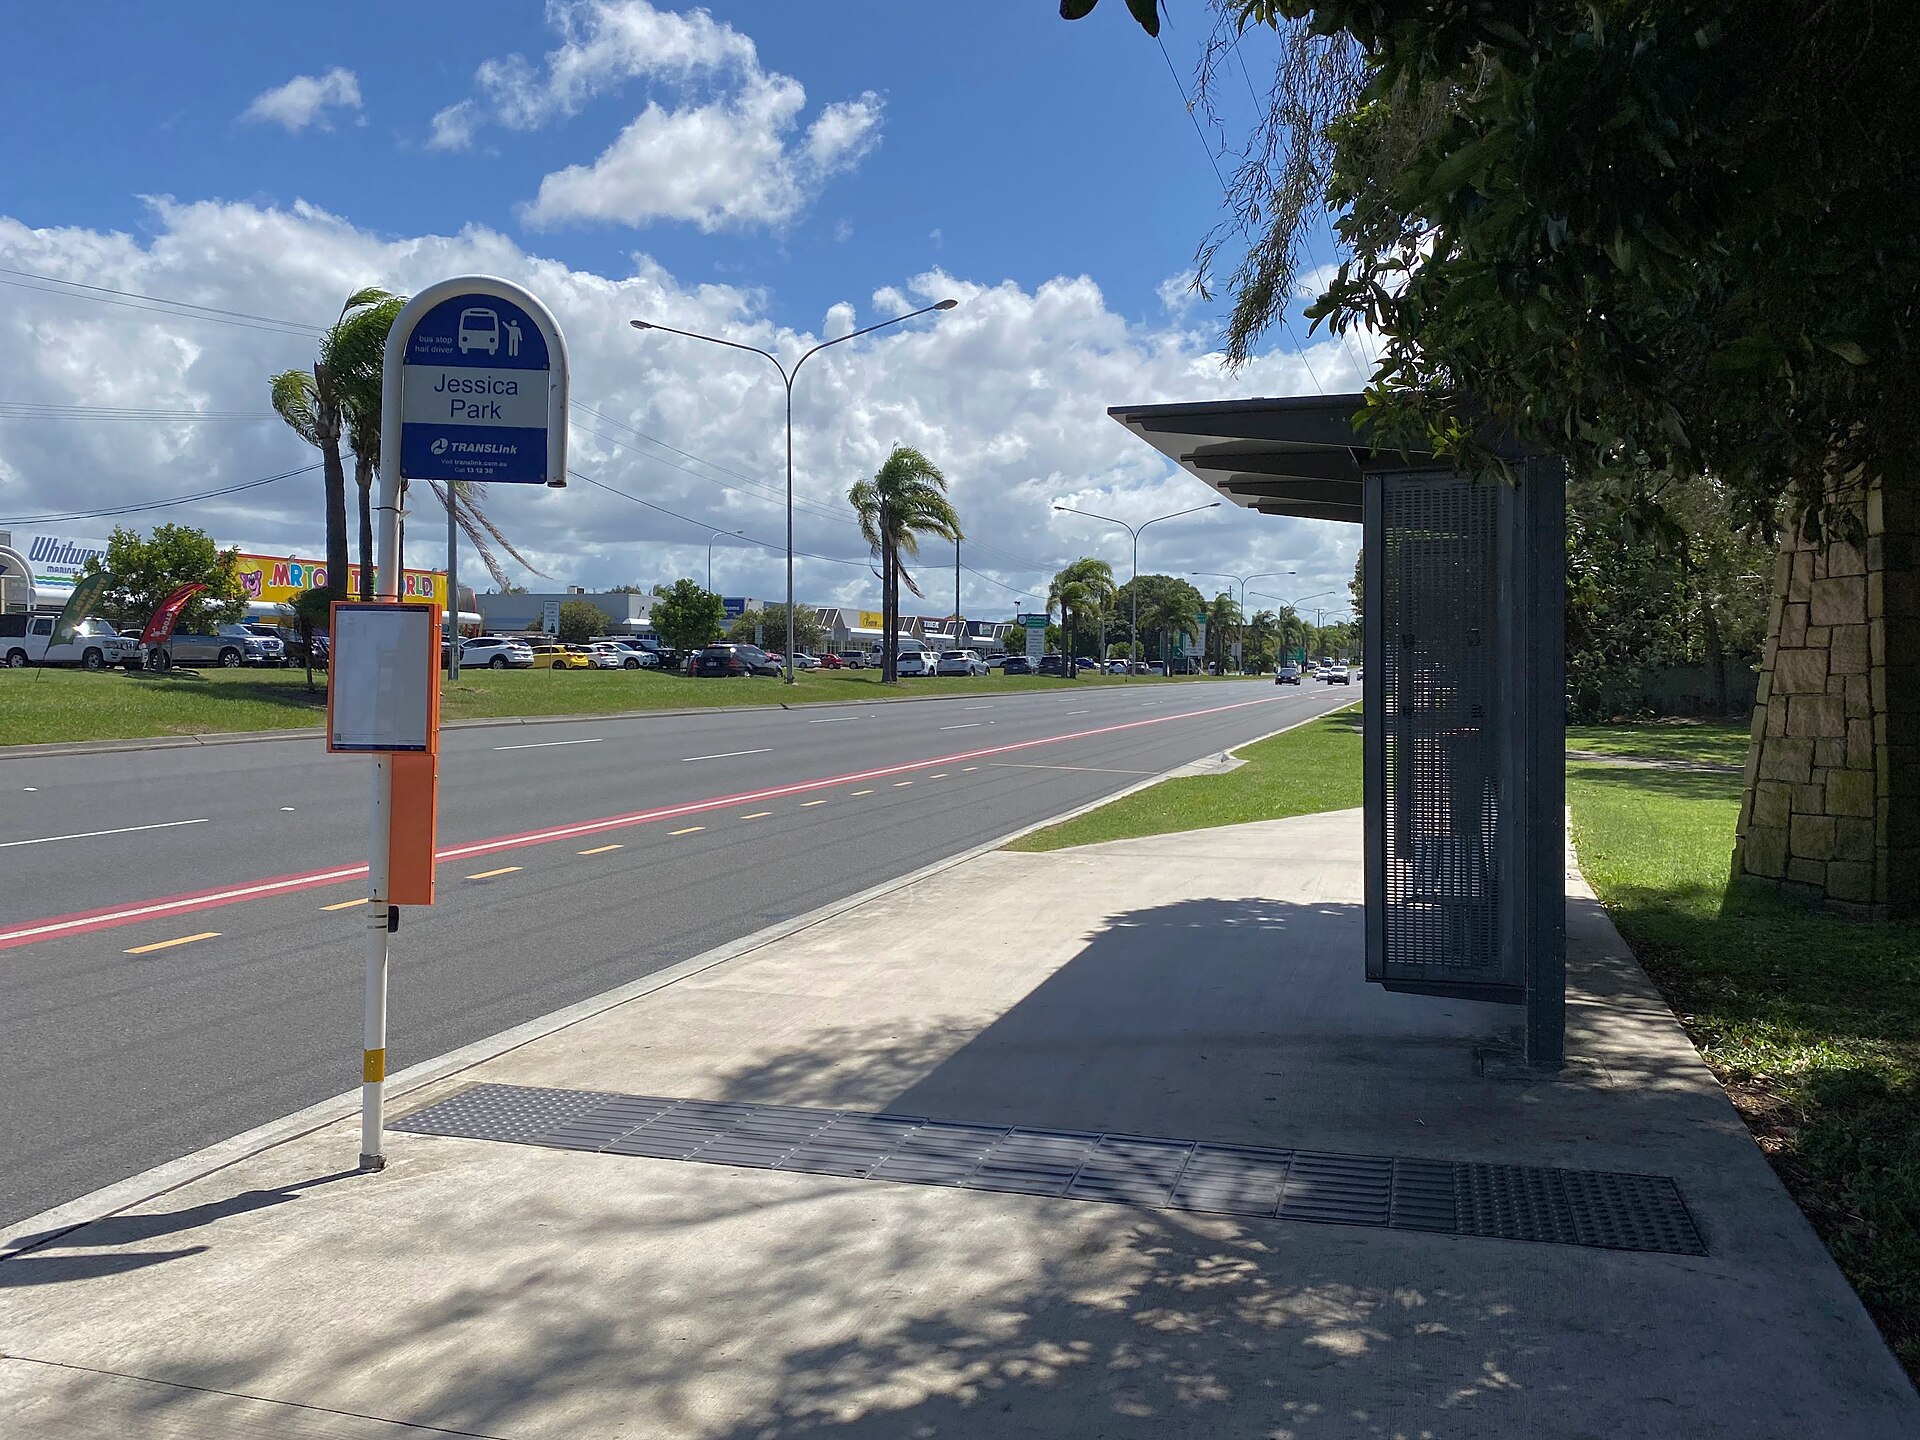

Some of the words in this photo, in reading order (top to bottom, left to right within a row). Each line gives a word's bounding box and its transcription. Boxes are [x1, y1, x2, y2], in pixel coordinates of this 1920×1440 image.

[419, 335, 434, 343] bus
[435, 335, 453, 345] stop
[415, 345, 430, 353] hail
[431, 346, 454, 354] driver
[434, 373, 519, 396] Jessica
[450, 399, 502, 420] Park
[451, 442, 518, 455] TRANSLink
[454, 459, 508, 467] translink.com.au
[484, 467, 494, 475] 30
[272, 562, 303, 588] MR
[160, 611, 173, 636] STOCK
